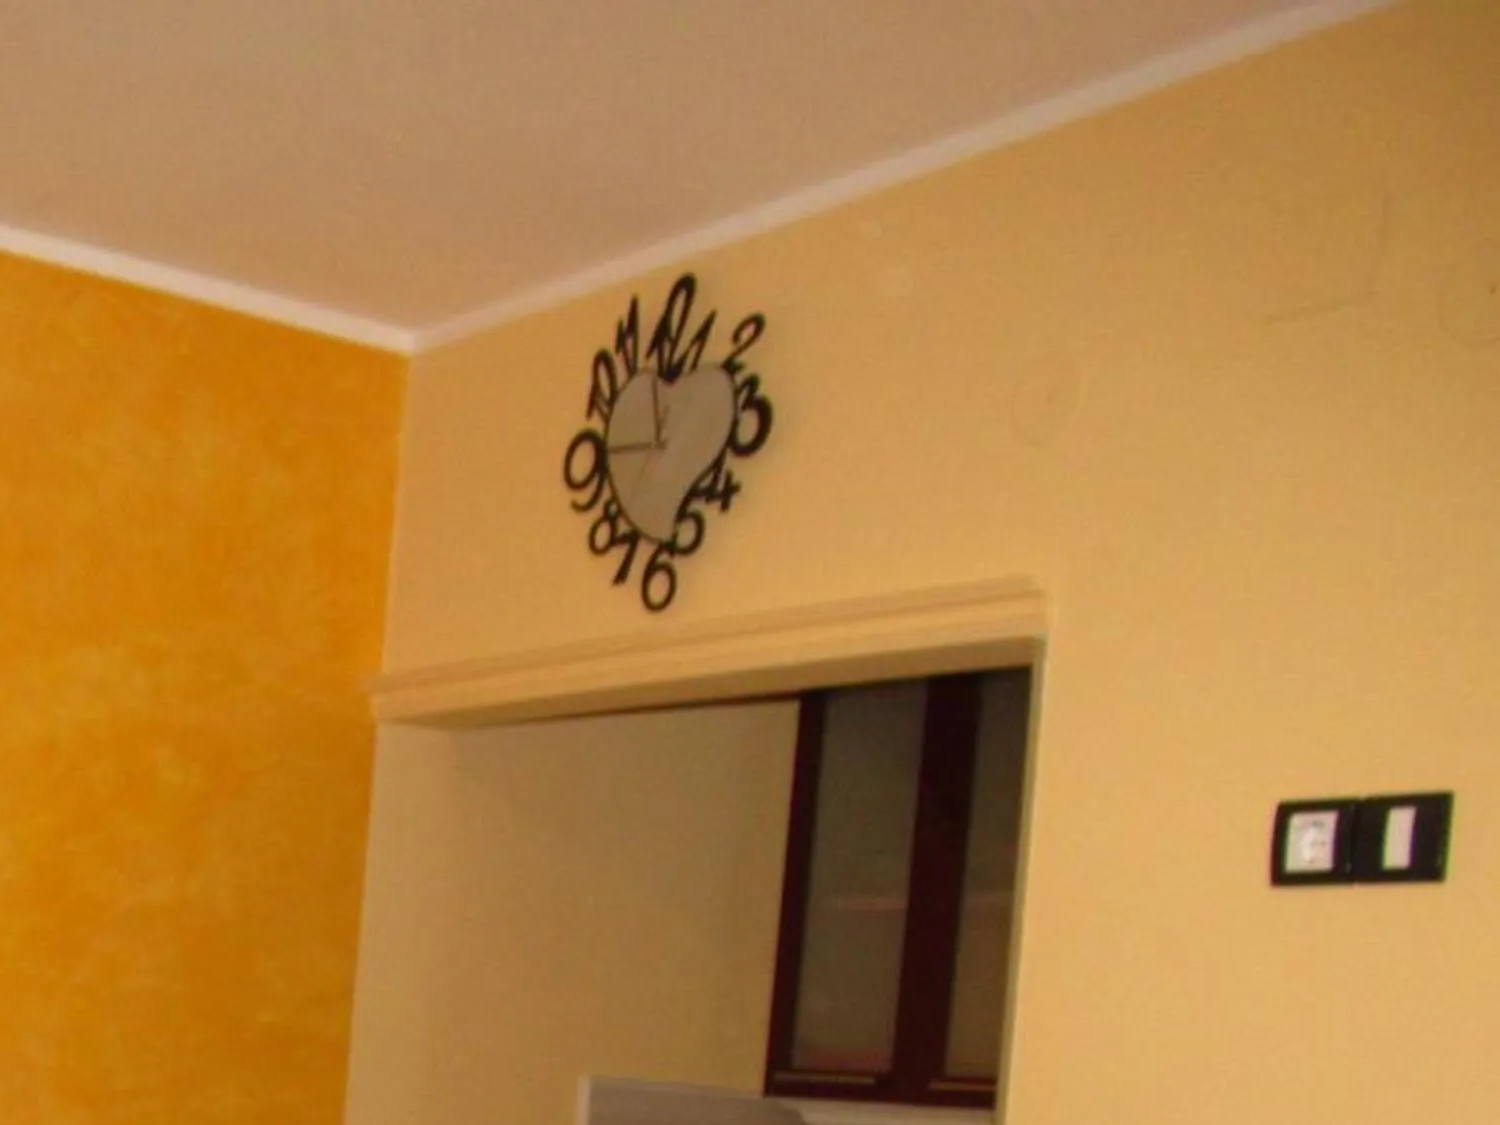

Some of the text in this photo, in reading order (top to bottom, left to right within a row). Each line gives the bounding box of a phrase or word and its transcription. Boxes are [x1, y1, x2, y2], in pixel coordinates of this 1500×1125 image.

[720, 313, 766, 376] 2
[734, 373, 773, 457] 3
[564, 428, 608, 513] 9
[693, 450, 742, 513] 4
[588, 498, 618, 556] 8
[612, 528, 640, 587] 7
[672, 498, 706, 557] 5
[641, 543, 677, 613] 6
